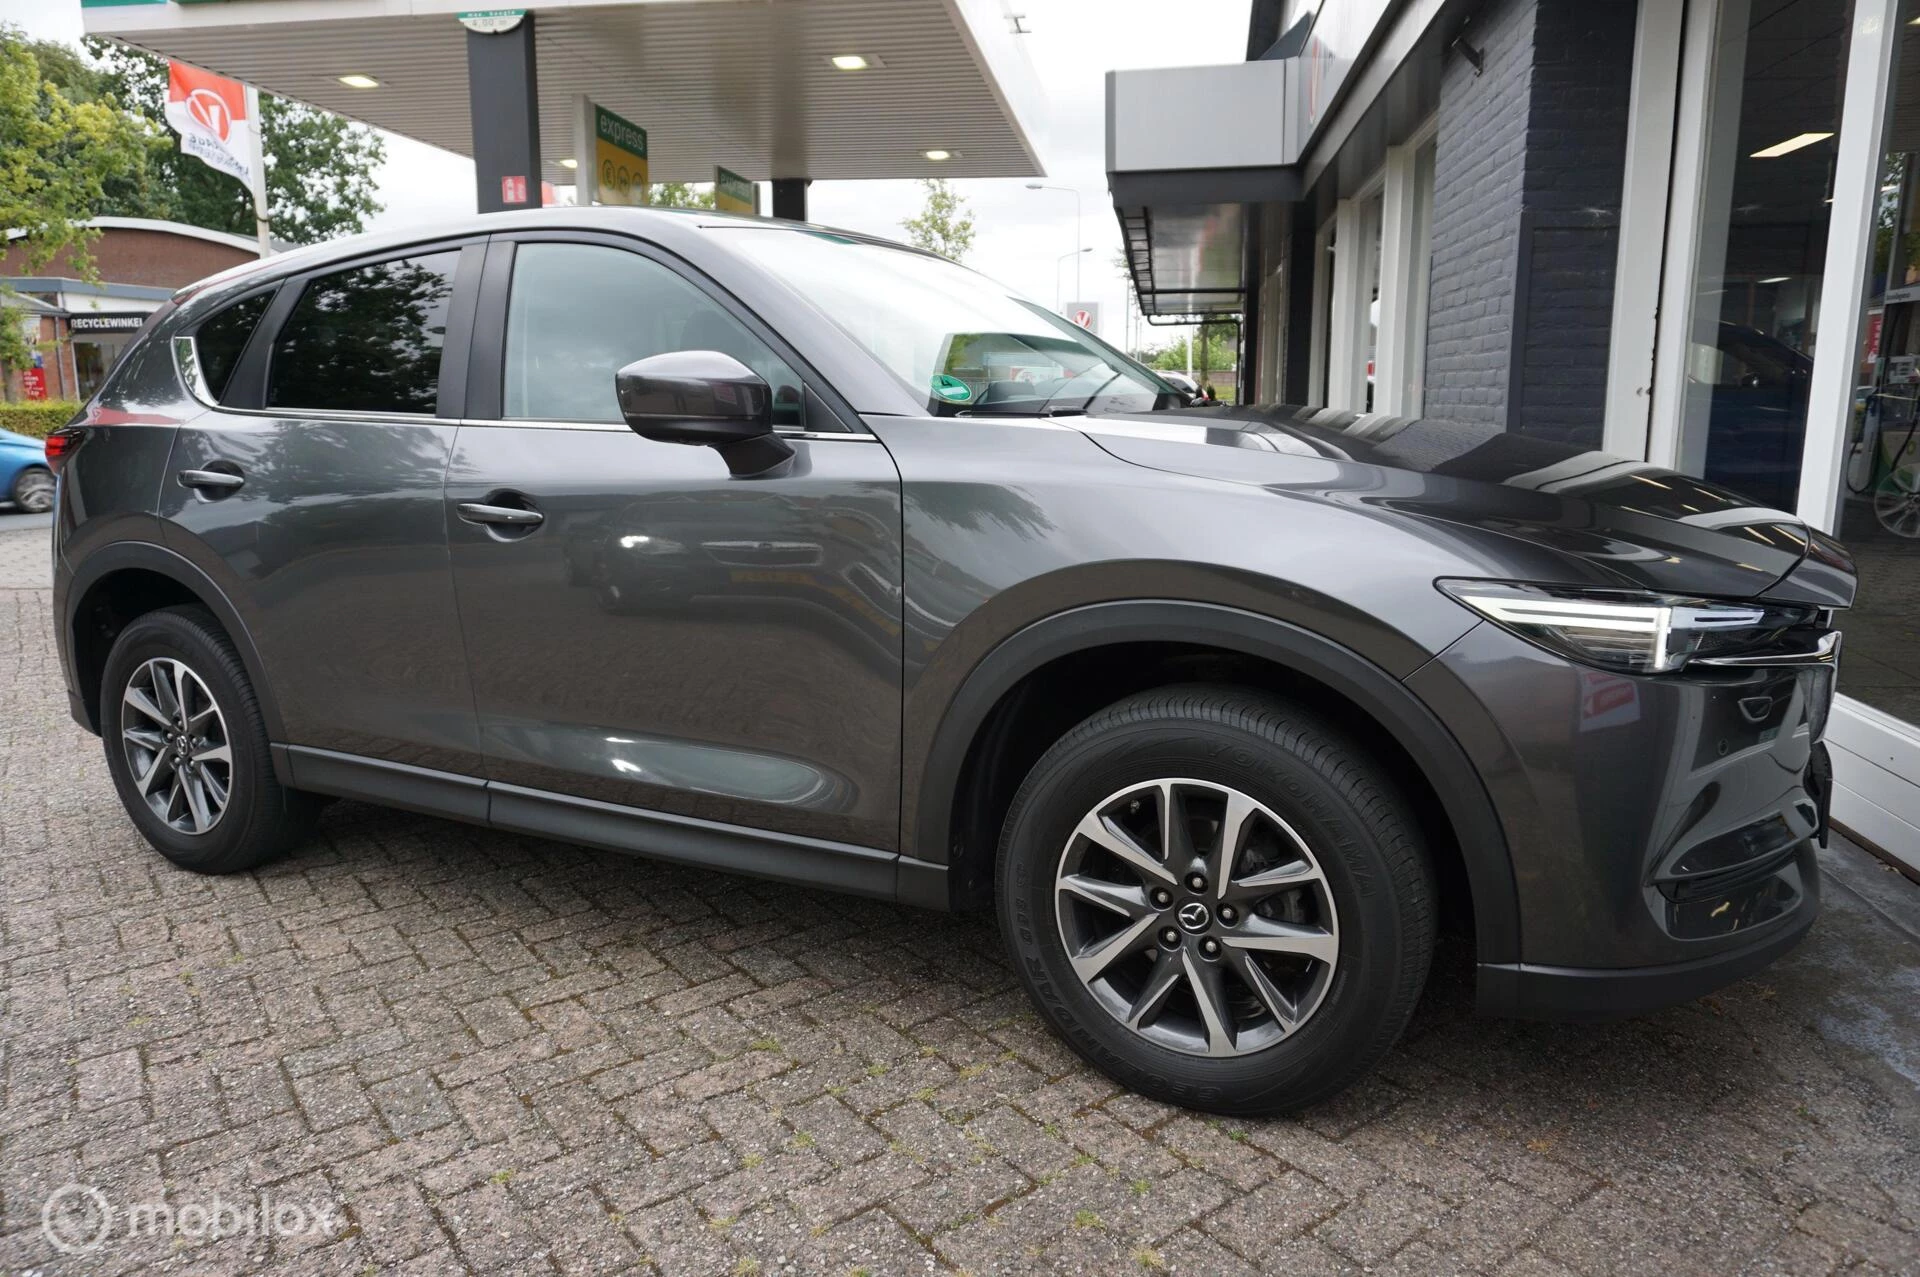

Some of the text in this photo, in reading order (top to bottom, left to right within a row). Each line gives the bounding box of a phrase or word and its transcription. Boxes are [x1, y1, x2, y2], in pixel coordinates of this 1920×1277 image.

[601, 115, 643, 150] express
[1207, 742, 1378, 898] YOKOHAMA
[1025, 956, 1222, 1103] GEOLANDAR
